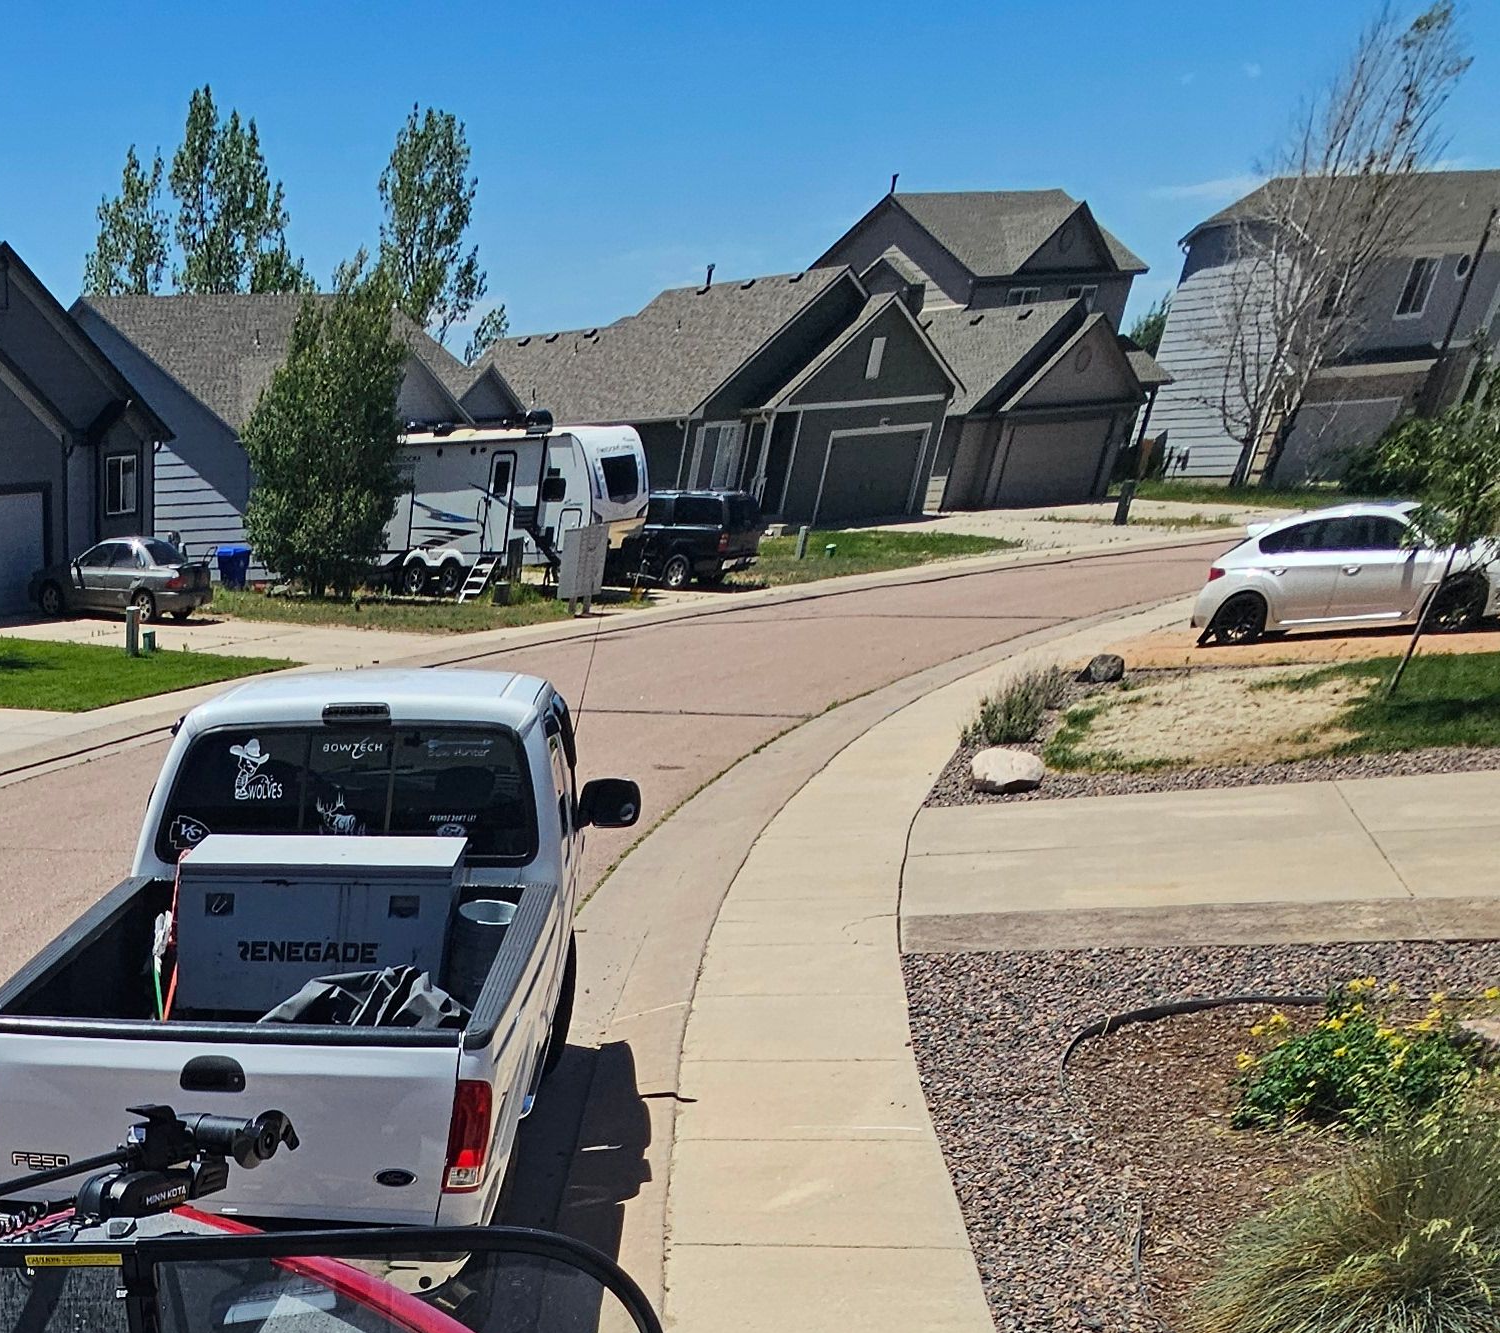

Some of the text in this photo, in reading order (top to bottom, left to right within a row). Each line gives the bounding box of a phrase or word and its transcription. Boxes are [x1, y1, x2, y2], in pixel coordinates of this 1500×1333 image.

[322, 737, 383, 760] BOWTECH
[248, 782, 283, 800] WOLVES
[181, 823, 202, 842] KC
[237, 940, 379, 964] RENEGADE
[12, 1152, 69, 1167] F250
[146, 1190, 167, 1206] MINN
[167, 1185, 187, 1199] KOTA
